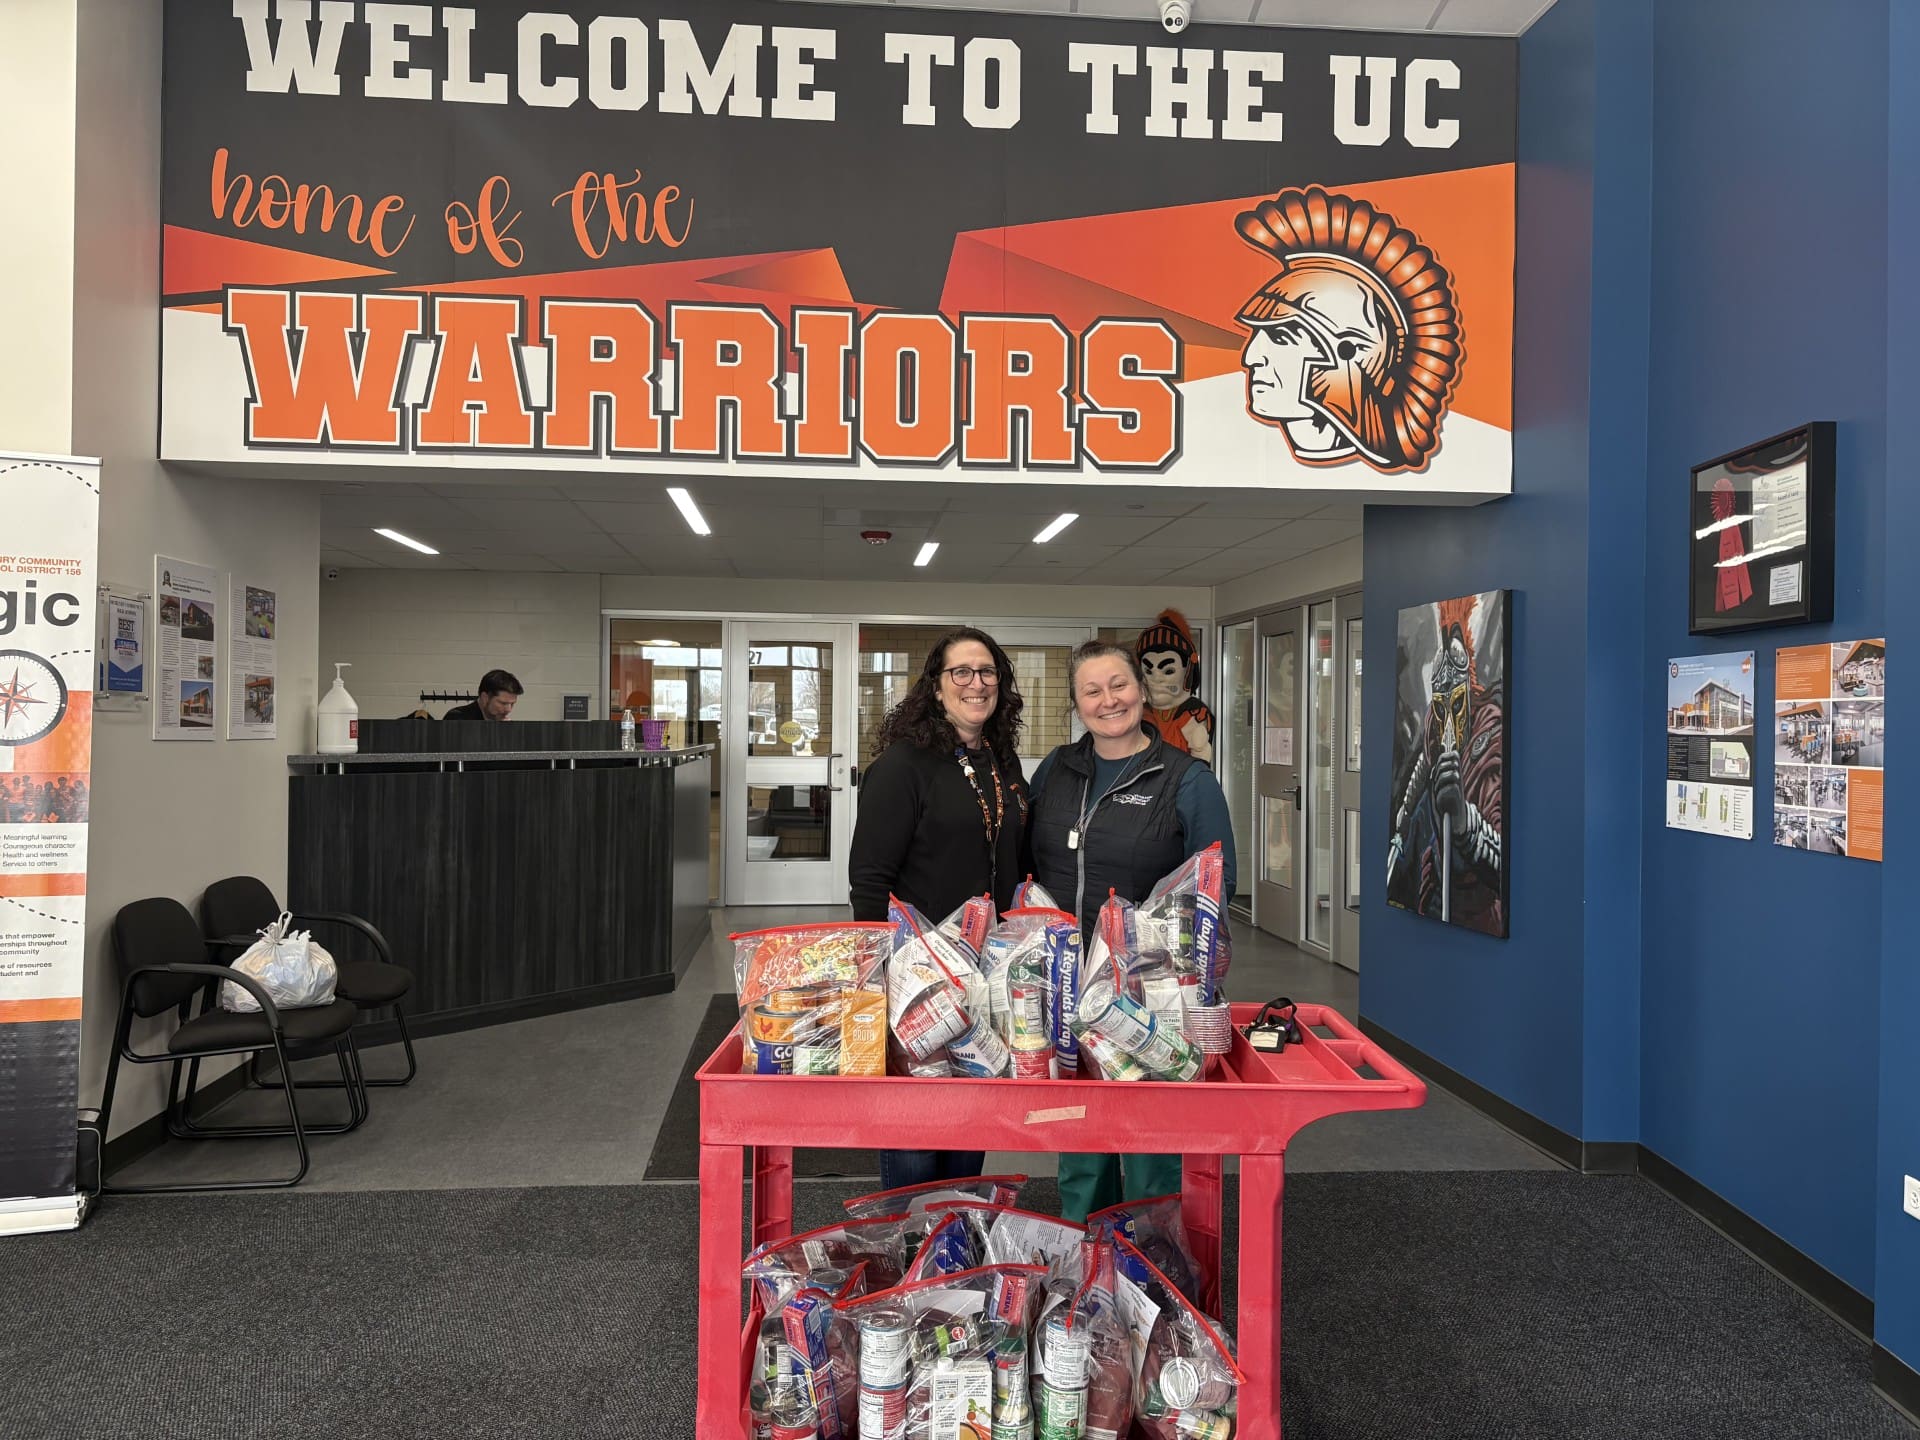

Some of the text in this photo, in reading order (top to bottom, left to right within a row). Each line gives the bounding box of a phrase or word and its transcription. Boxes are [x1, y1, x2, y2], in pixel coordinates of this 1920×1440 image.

[233, 0, 1461, 148] WELCOME TO THE UC
[211, 148, 694, 267] home of the
[224, 288, 1182, 469] WARRIORS
[17, 565, 62, 575] DISTRICT
[65, 568, 81, 576] 156
[18, 556, 81, 567] COMMUNITY
[21, 932, 56, 940] empower
[1196, 916, 1214, 951] Wrap
[1060, 950, 1076, 1011] Reynolds
